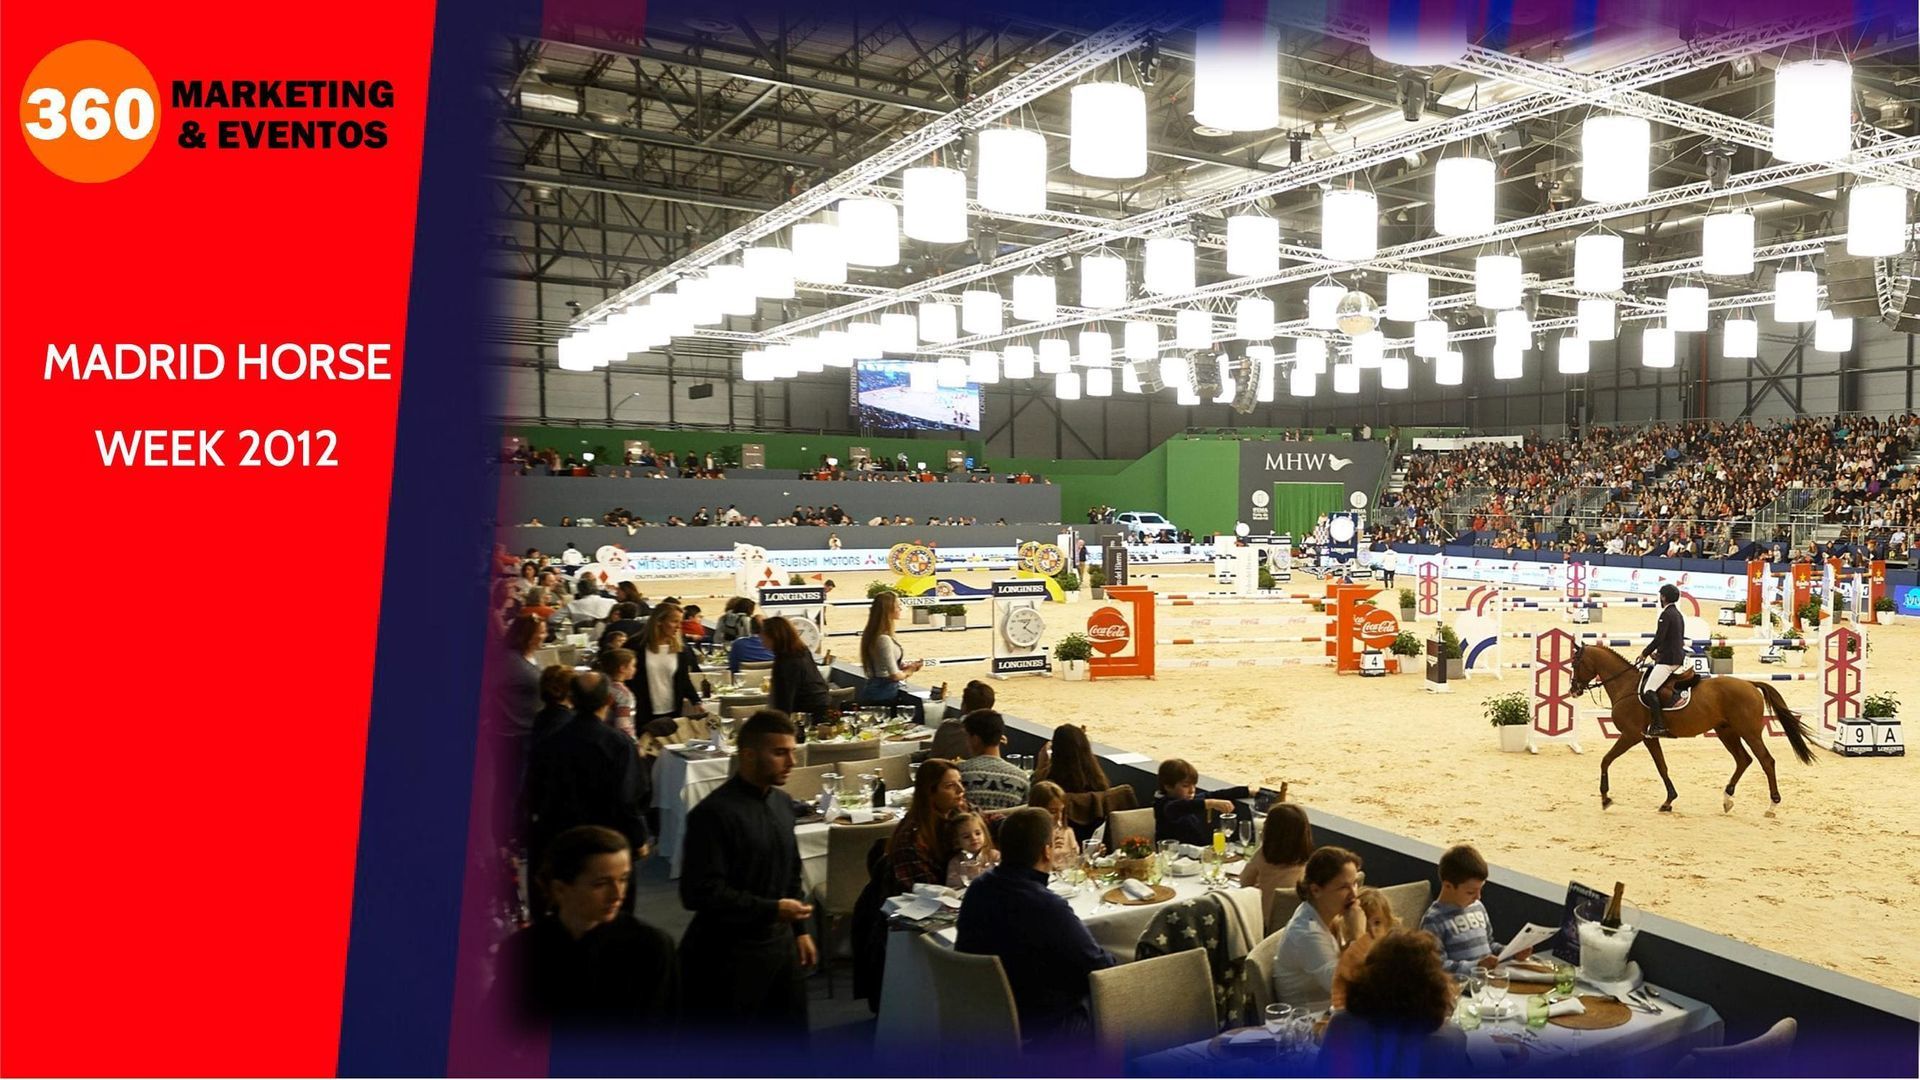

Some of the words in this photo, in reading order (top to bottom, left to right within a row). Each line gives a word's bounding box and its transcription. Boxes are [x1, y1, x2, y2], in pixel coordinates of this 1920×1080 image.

[1265, 453, 1325, 471] MHW
[637, 559, 697, 570] MITSUBISHI
[823, 556, 860, 566] MOTORS
[998, 585, 1044, 594] LONGINES
[765, 592, 821, 601] LONGINES
[999, 660, 1044, 669] LONGINES
[1371, 656, 1378, 667] 4
[1695, 659, 1702, 670] B
[1856, 728, 1864, 743] 9
[1885, 727, 1896, 743] A
